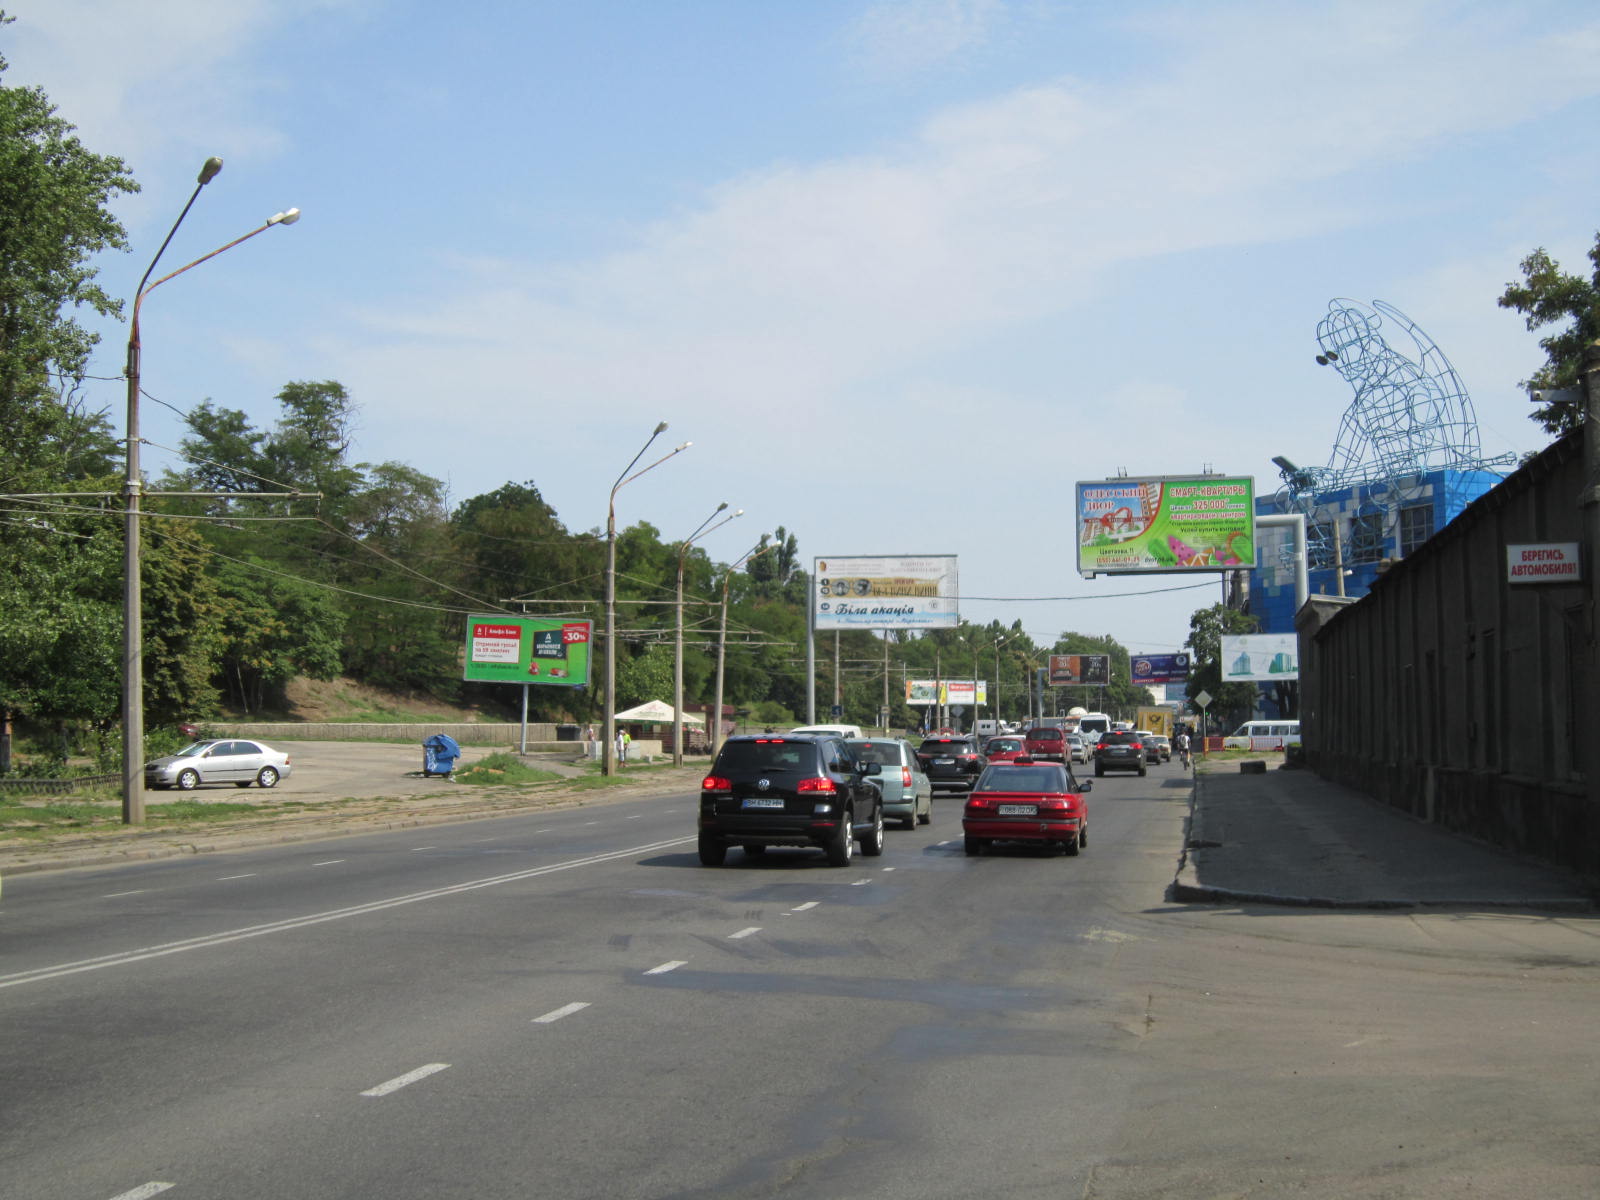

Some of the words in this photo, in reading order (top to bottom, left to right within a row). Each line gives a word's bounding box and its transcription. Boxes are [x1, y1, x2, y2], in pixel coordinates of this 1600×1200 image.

[1084, 488, 1147, 498] ОДЕССКИЙ
[1170, 485, 1246, 497] СМАРТ-КВАРТИРЫ
[1085, 501, 1114, 511] ДВОР
[1193, 500, 1208, 510] 325
[1521, 549, 1564, 561] БЕРЕГИСЬ
[1511, 563, 1577, 576] АВТОМОБИЛЯ!
[835, 603, 867, 615] Біла
[870, 604, 914, 617] акація
